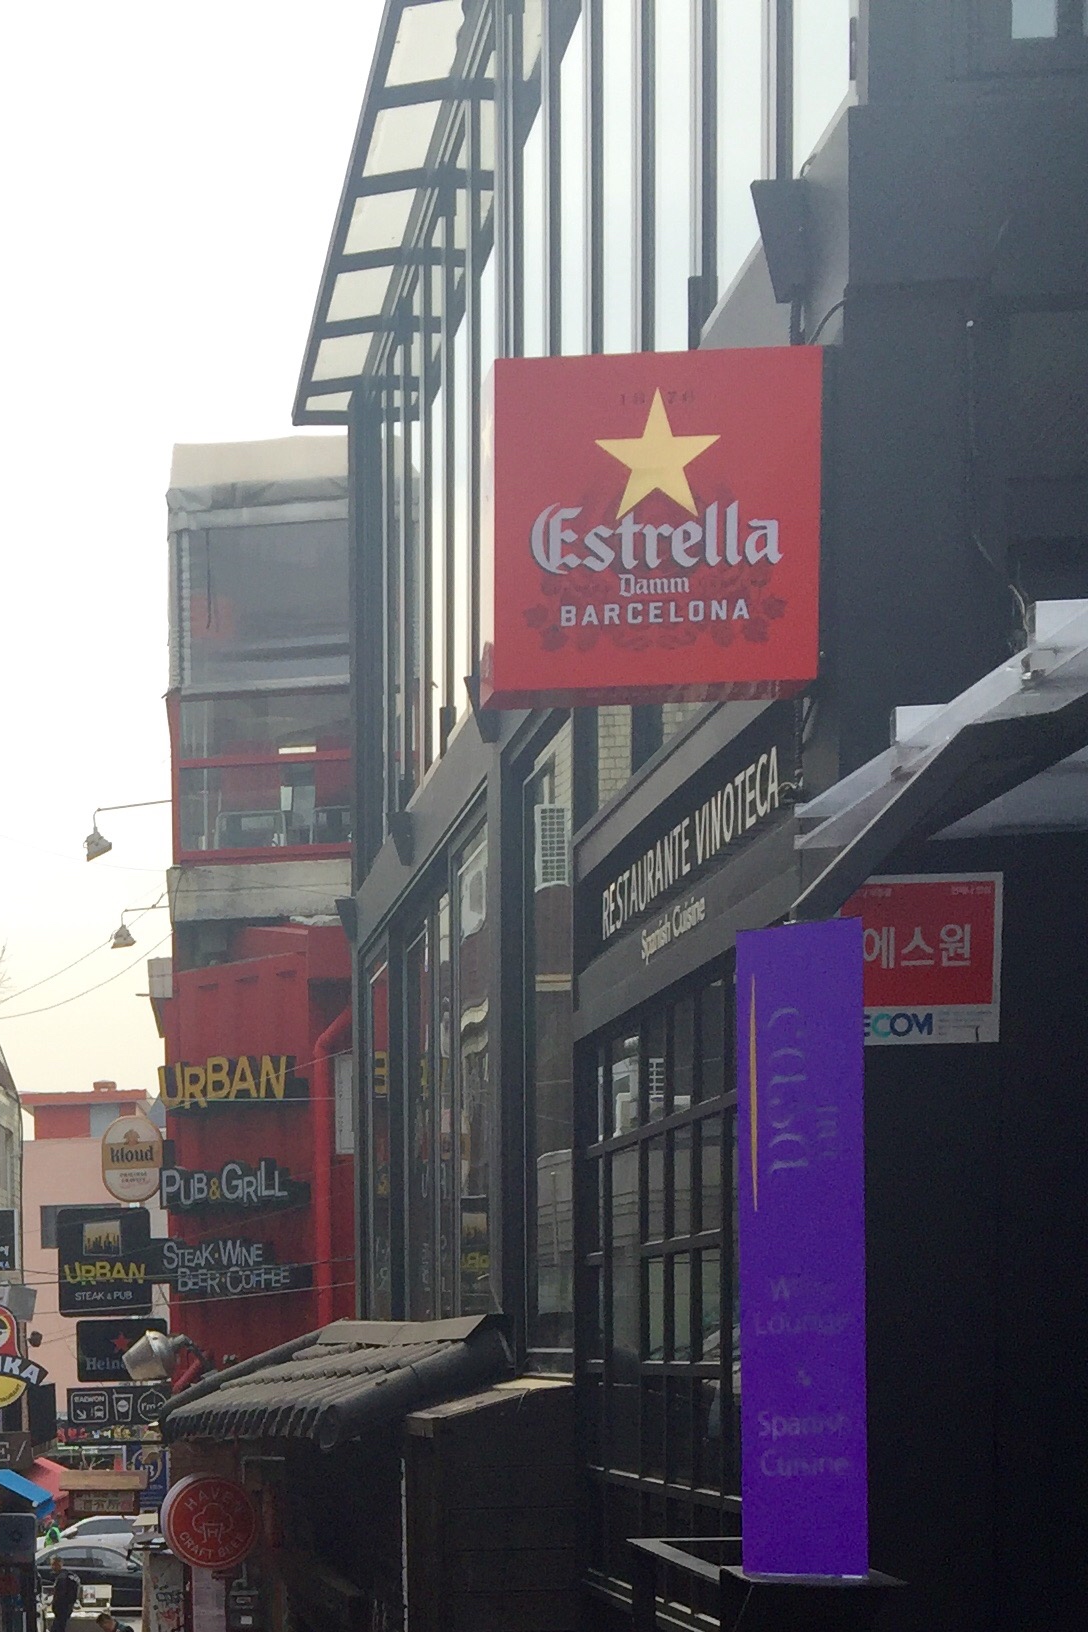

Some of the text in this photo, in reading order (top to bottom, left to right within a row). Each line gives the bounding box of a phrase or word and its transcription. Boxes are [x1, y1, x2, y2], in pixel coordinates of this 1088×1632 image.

[530, 500, 784, 575] Estrella
[618, 573, 690, 597] Damm
[560, 598, 750, 627] BARCELONA
[602, 745, 780, 941] RESTAURANTE VINOTECA
[641, 896, 706, 966] Spanish Cuisine
[863, 923, 972, 969] 에스원
[157, 1055, 287, 1109] URBAN
[64, 1261, 146, 1286] URBAN
[75, 1291, 105, 1301] STEAK
[113, 1290, 134, 1300] PUB
[85, 1356, 126, 1371] Hein
[180, 1531, 213, 1558] CRAFT
